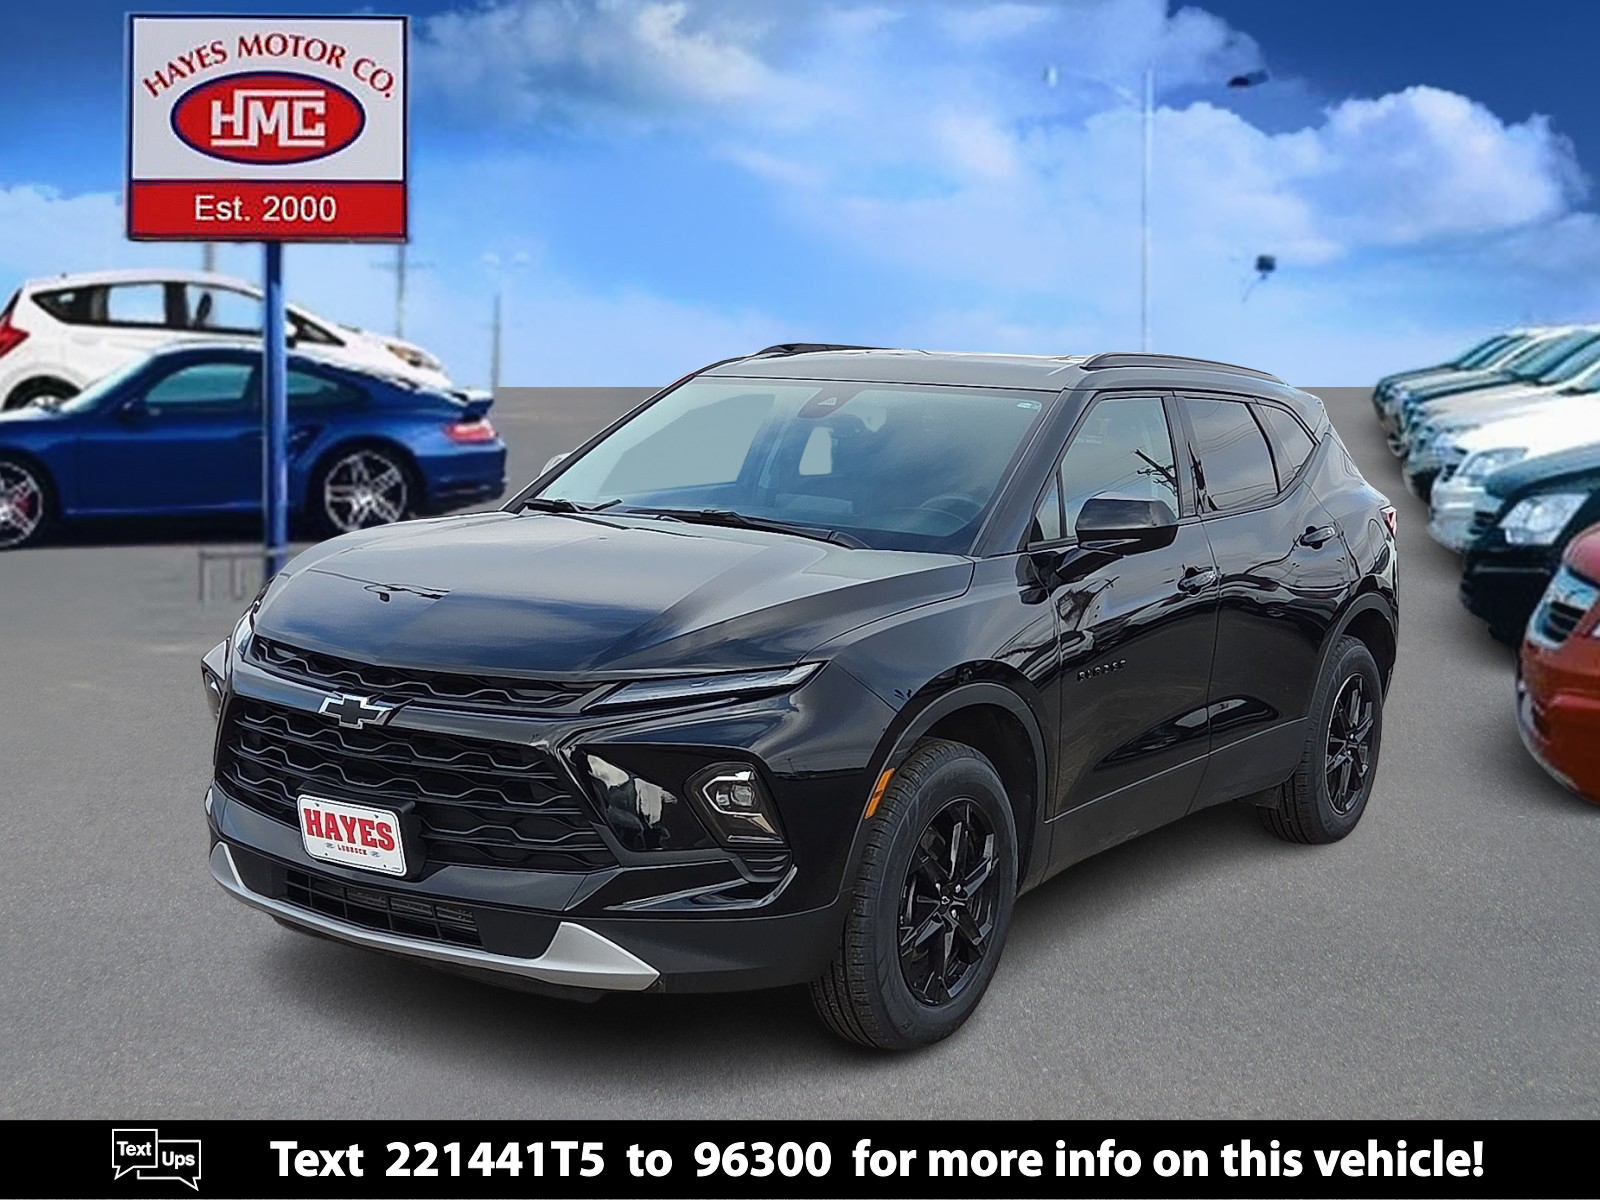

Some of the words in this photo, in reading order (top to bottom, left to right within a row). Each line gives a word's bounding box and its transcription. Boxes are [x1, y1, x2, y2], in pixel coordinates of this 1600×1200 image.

[143, 40, 228, 98] HAYES
[237, 33, 347, 70] MOTOR
[352, 57, 395, 99] CO.
[210, 88, 326, 148] HMC
[194, 194, 251, 222] Est.
[261, 195, 337, 222] 2000
[303, 808, 396, 852] HAYES
